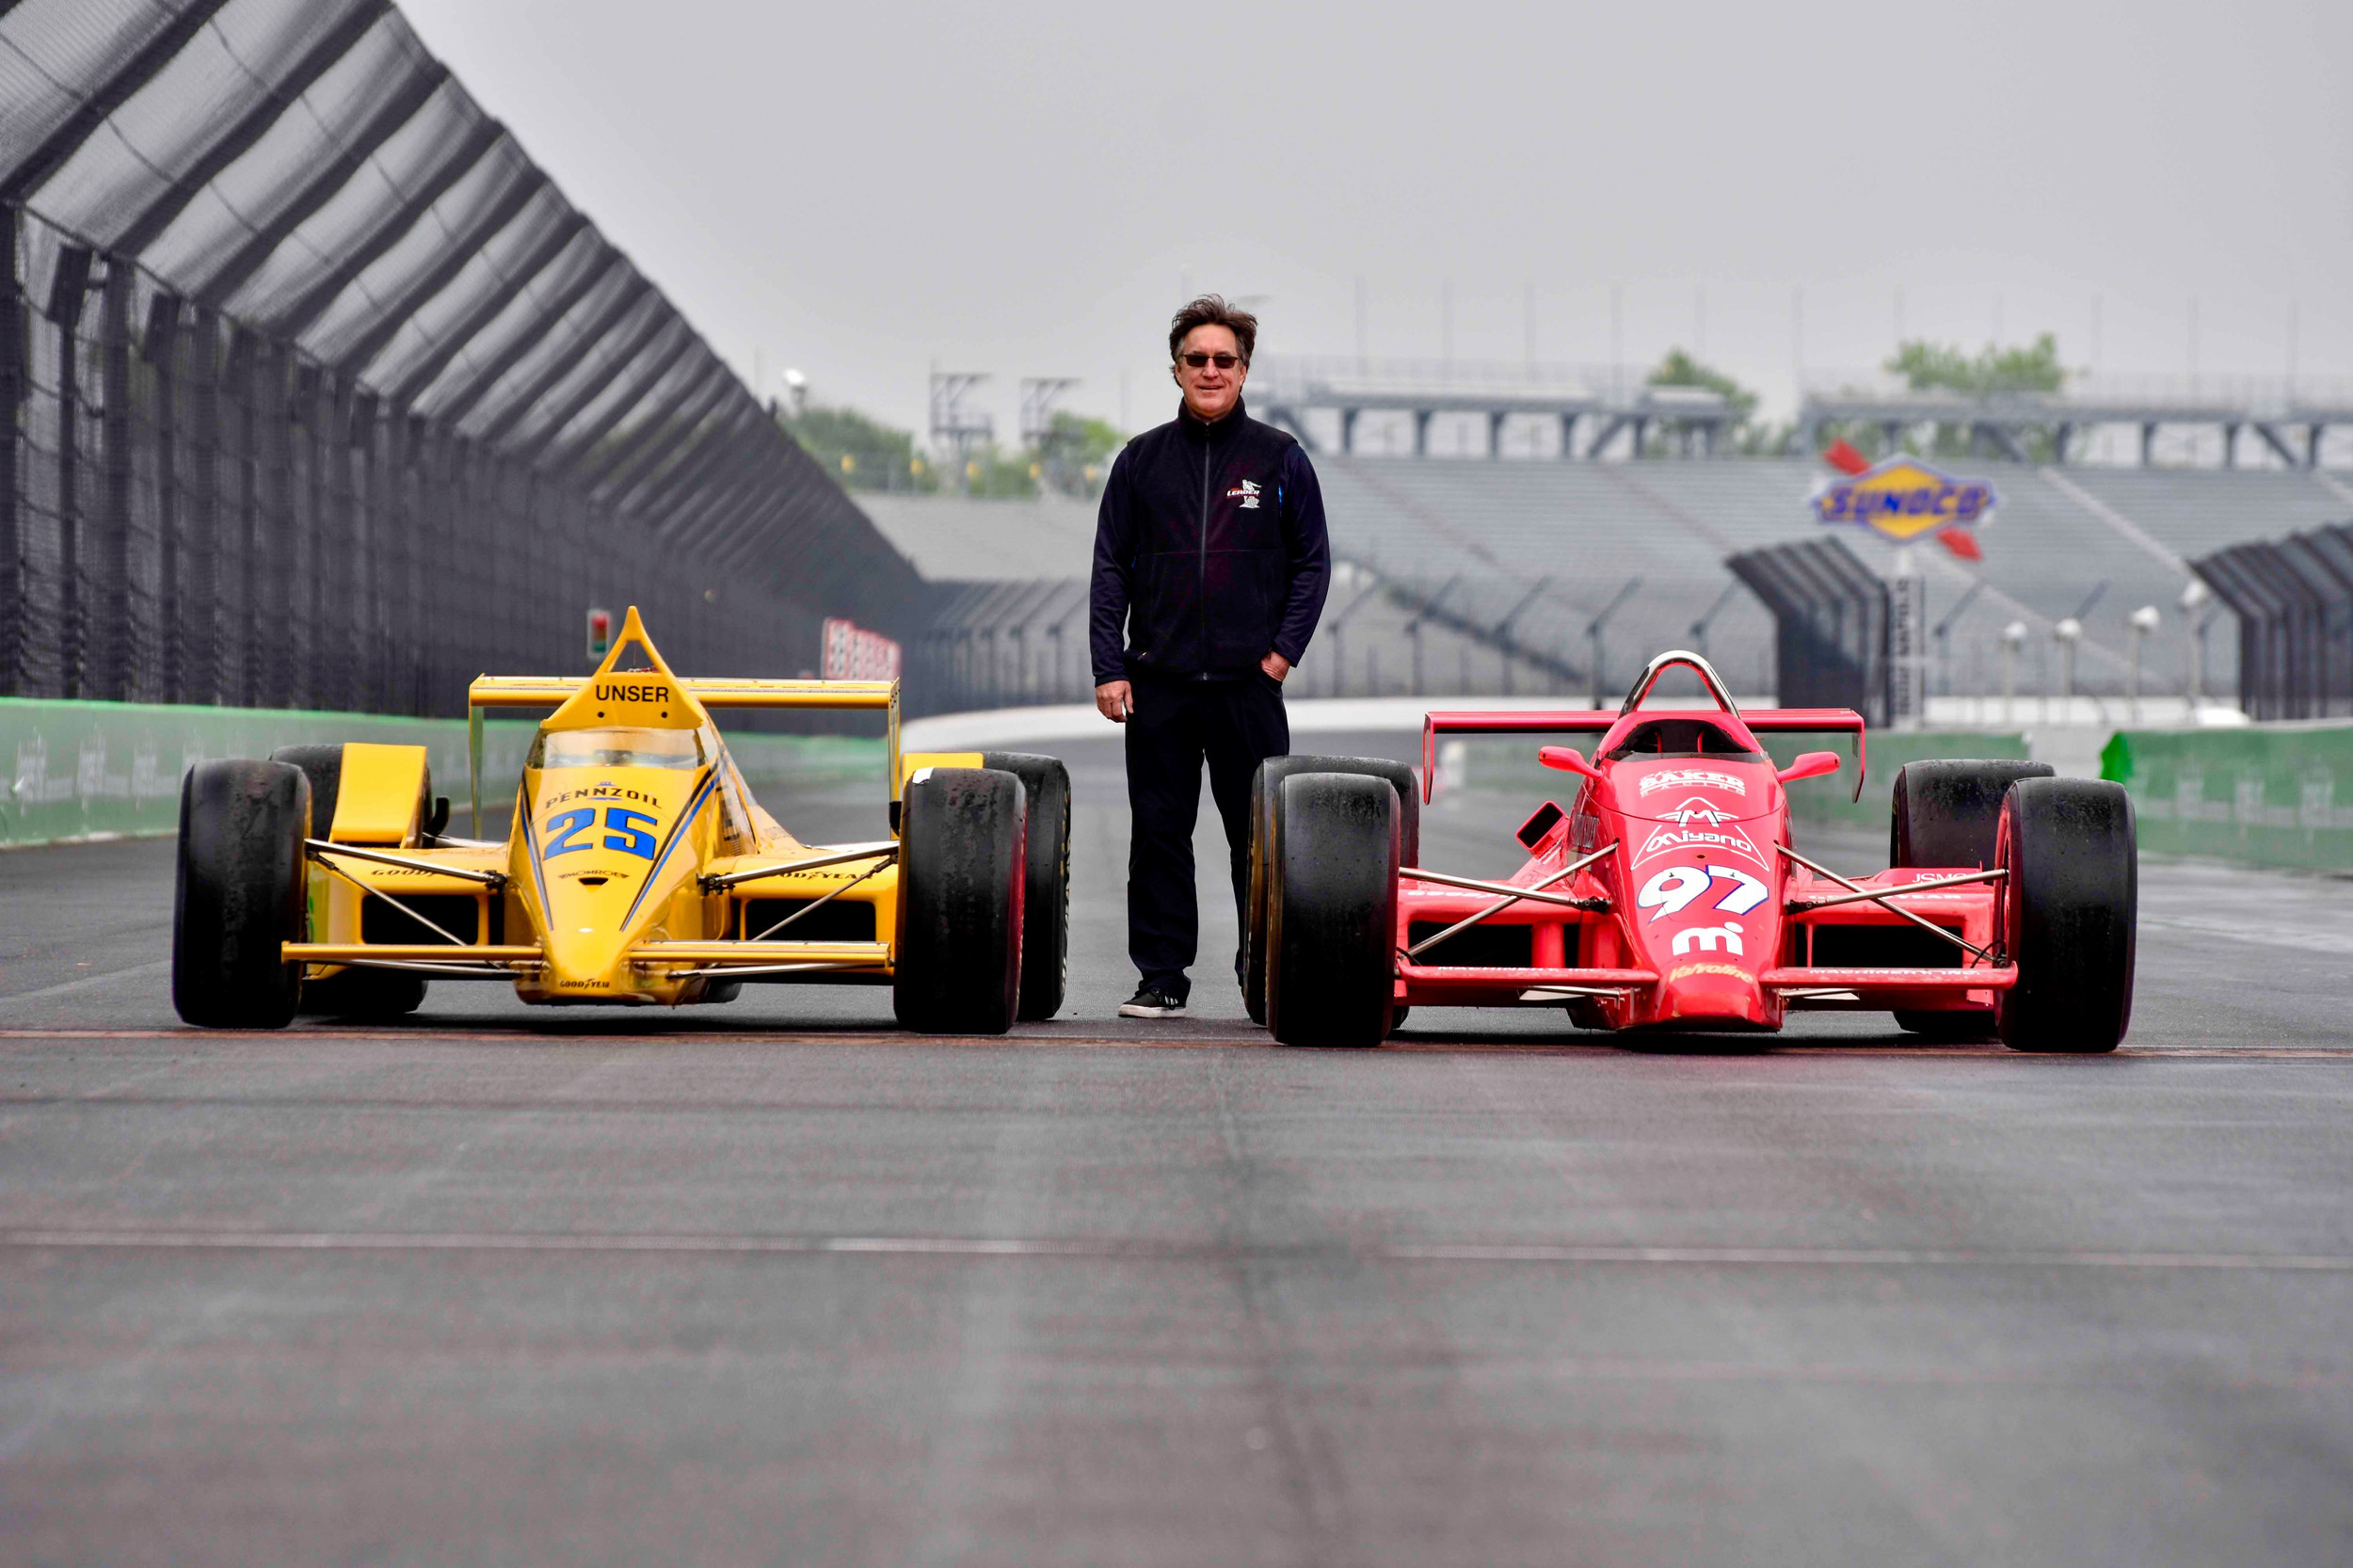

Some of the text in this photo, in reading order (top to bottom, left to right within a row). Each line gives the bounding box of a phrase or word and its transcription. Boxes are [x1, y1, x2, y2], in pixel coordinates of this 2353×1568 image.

[1821, 485, 1988, 520] SUNOCO
[595, 684, 669, 703] UNSER
[1639, 771, 1745, 790] BAKER
[545, 787, 663, 809] PENNZOIL
[542, 807, 658, 861] 25
[1646, 829, 1752, 853] Miyano
[564, 870, 622, 879] MONROE
[1636, 864, 1769, 924] 97
[1669, 963, 1753, 984] Valvoline
